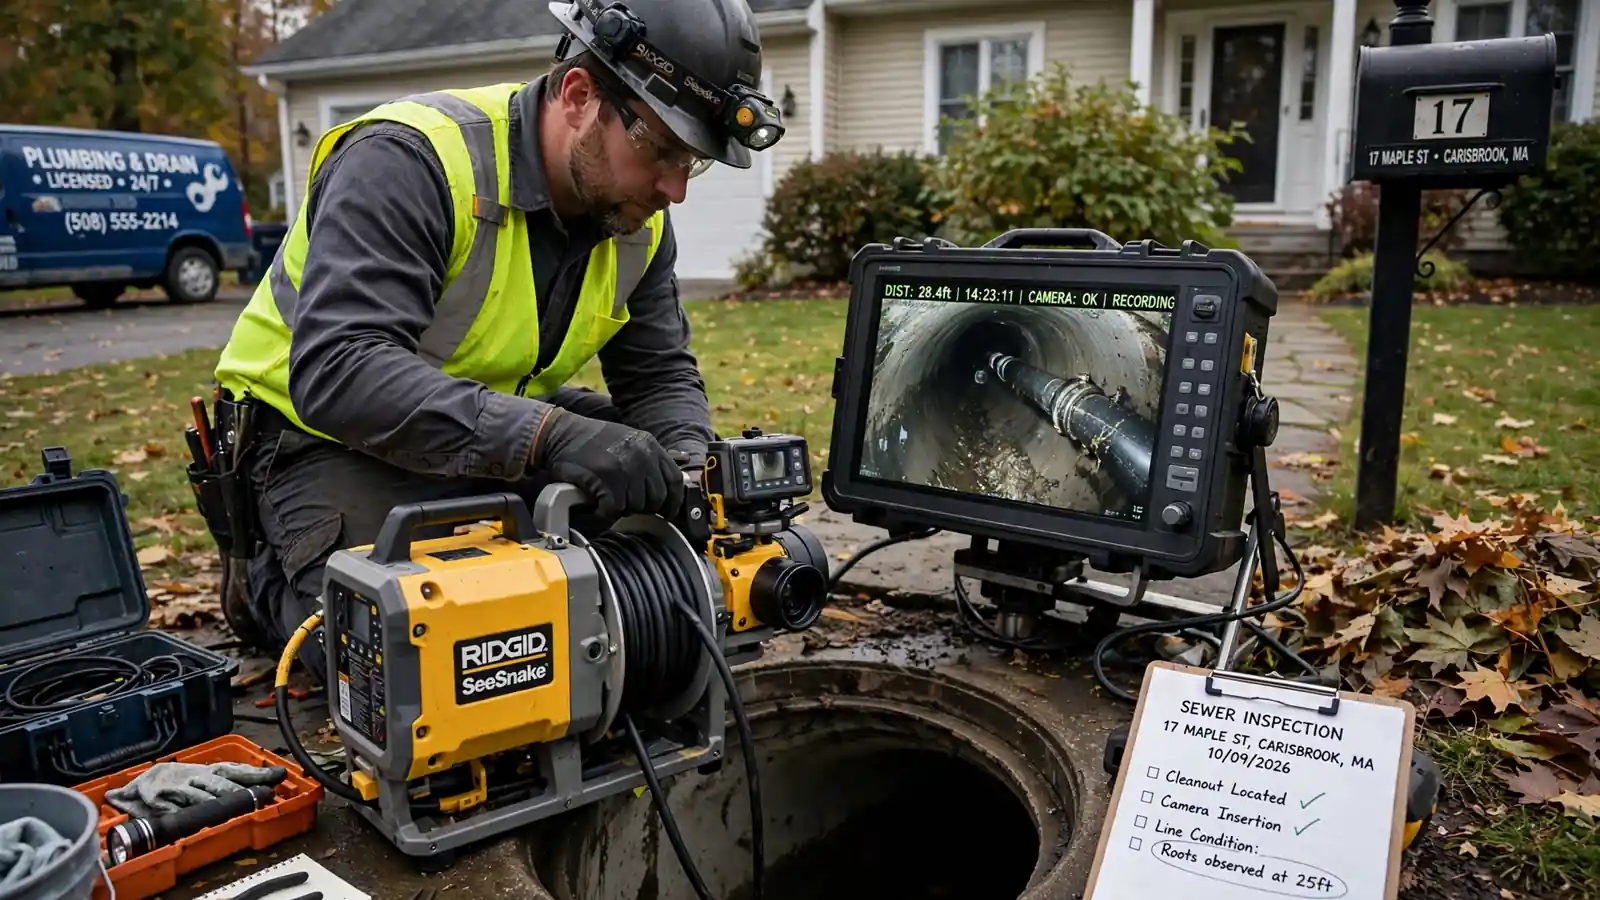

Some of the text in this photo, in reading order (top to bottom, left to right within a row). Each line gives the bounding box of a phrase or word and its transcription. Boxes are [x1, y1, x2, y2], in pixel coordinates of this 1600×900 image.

[1432, 97, 1475, 135] 17
[22, 146, 200, 175] PLUMBING & DRAIN
[1368, 146, 1529, 166] 17 MAPLE ST CARISBROOK, MA
[46, 171, 159, 193] LICENSED 24/7
[65, 211, 180, 235] (508) 555-2214
[885, 284, 914, 298] DIST:
[918, 285, 952, 300] 28.4ft
[965, 287, 1014, 302] 14:23:11
[1028, 290, 1077, 305] CAMERA:
[1082, 292, 1099, 306] OK
[1112, 293, 1176, 309] RECORDING
[461, 631, 547, 669] RIDGID
[462, 664, 547, 696] SeeSnake
[1180, 699, 1344, 741] SEWER INSPECTION
[1163, 719, 1375, 772] 17 MAPLE ST, CARISBROOK, MA
[1207, 746, 1292, 774] 10/09/2026
[1165, 770, 1287, 806] Cleanout Located
[1160, 794, 1282, 833] Camera Insertion
[1155, 819, 1259, 855] Line Condition:
[1161, 842, 1333, 893] Roots observed at 25ft
